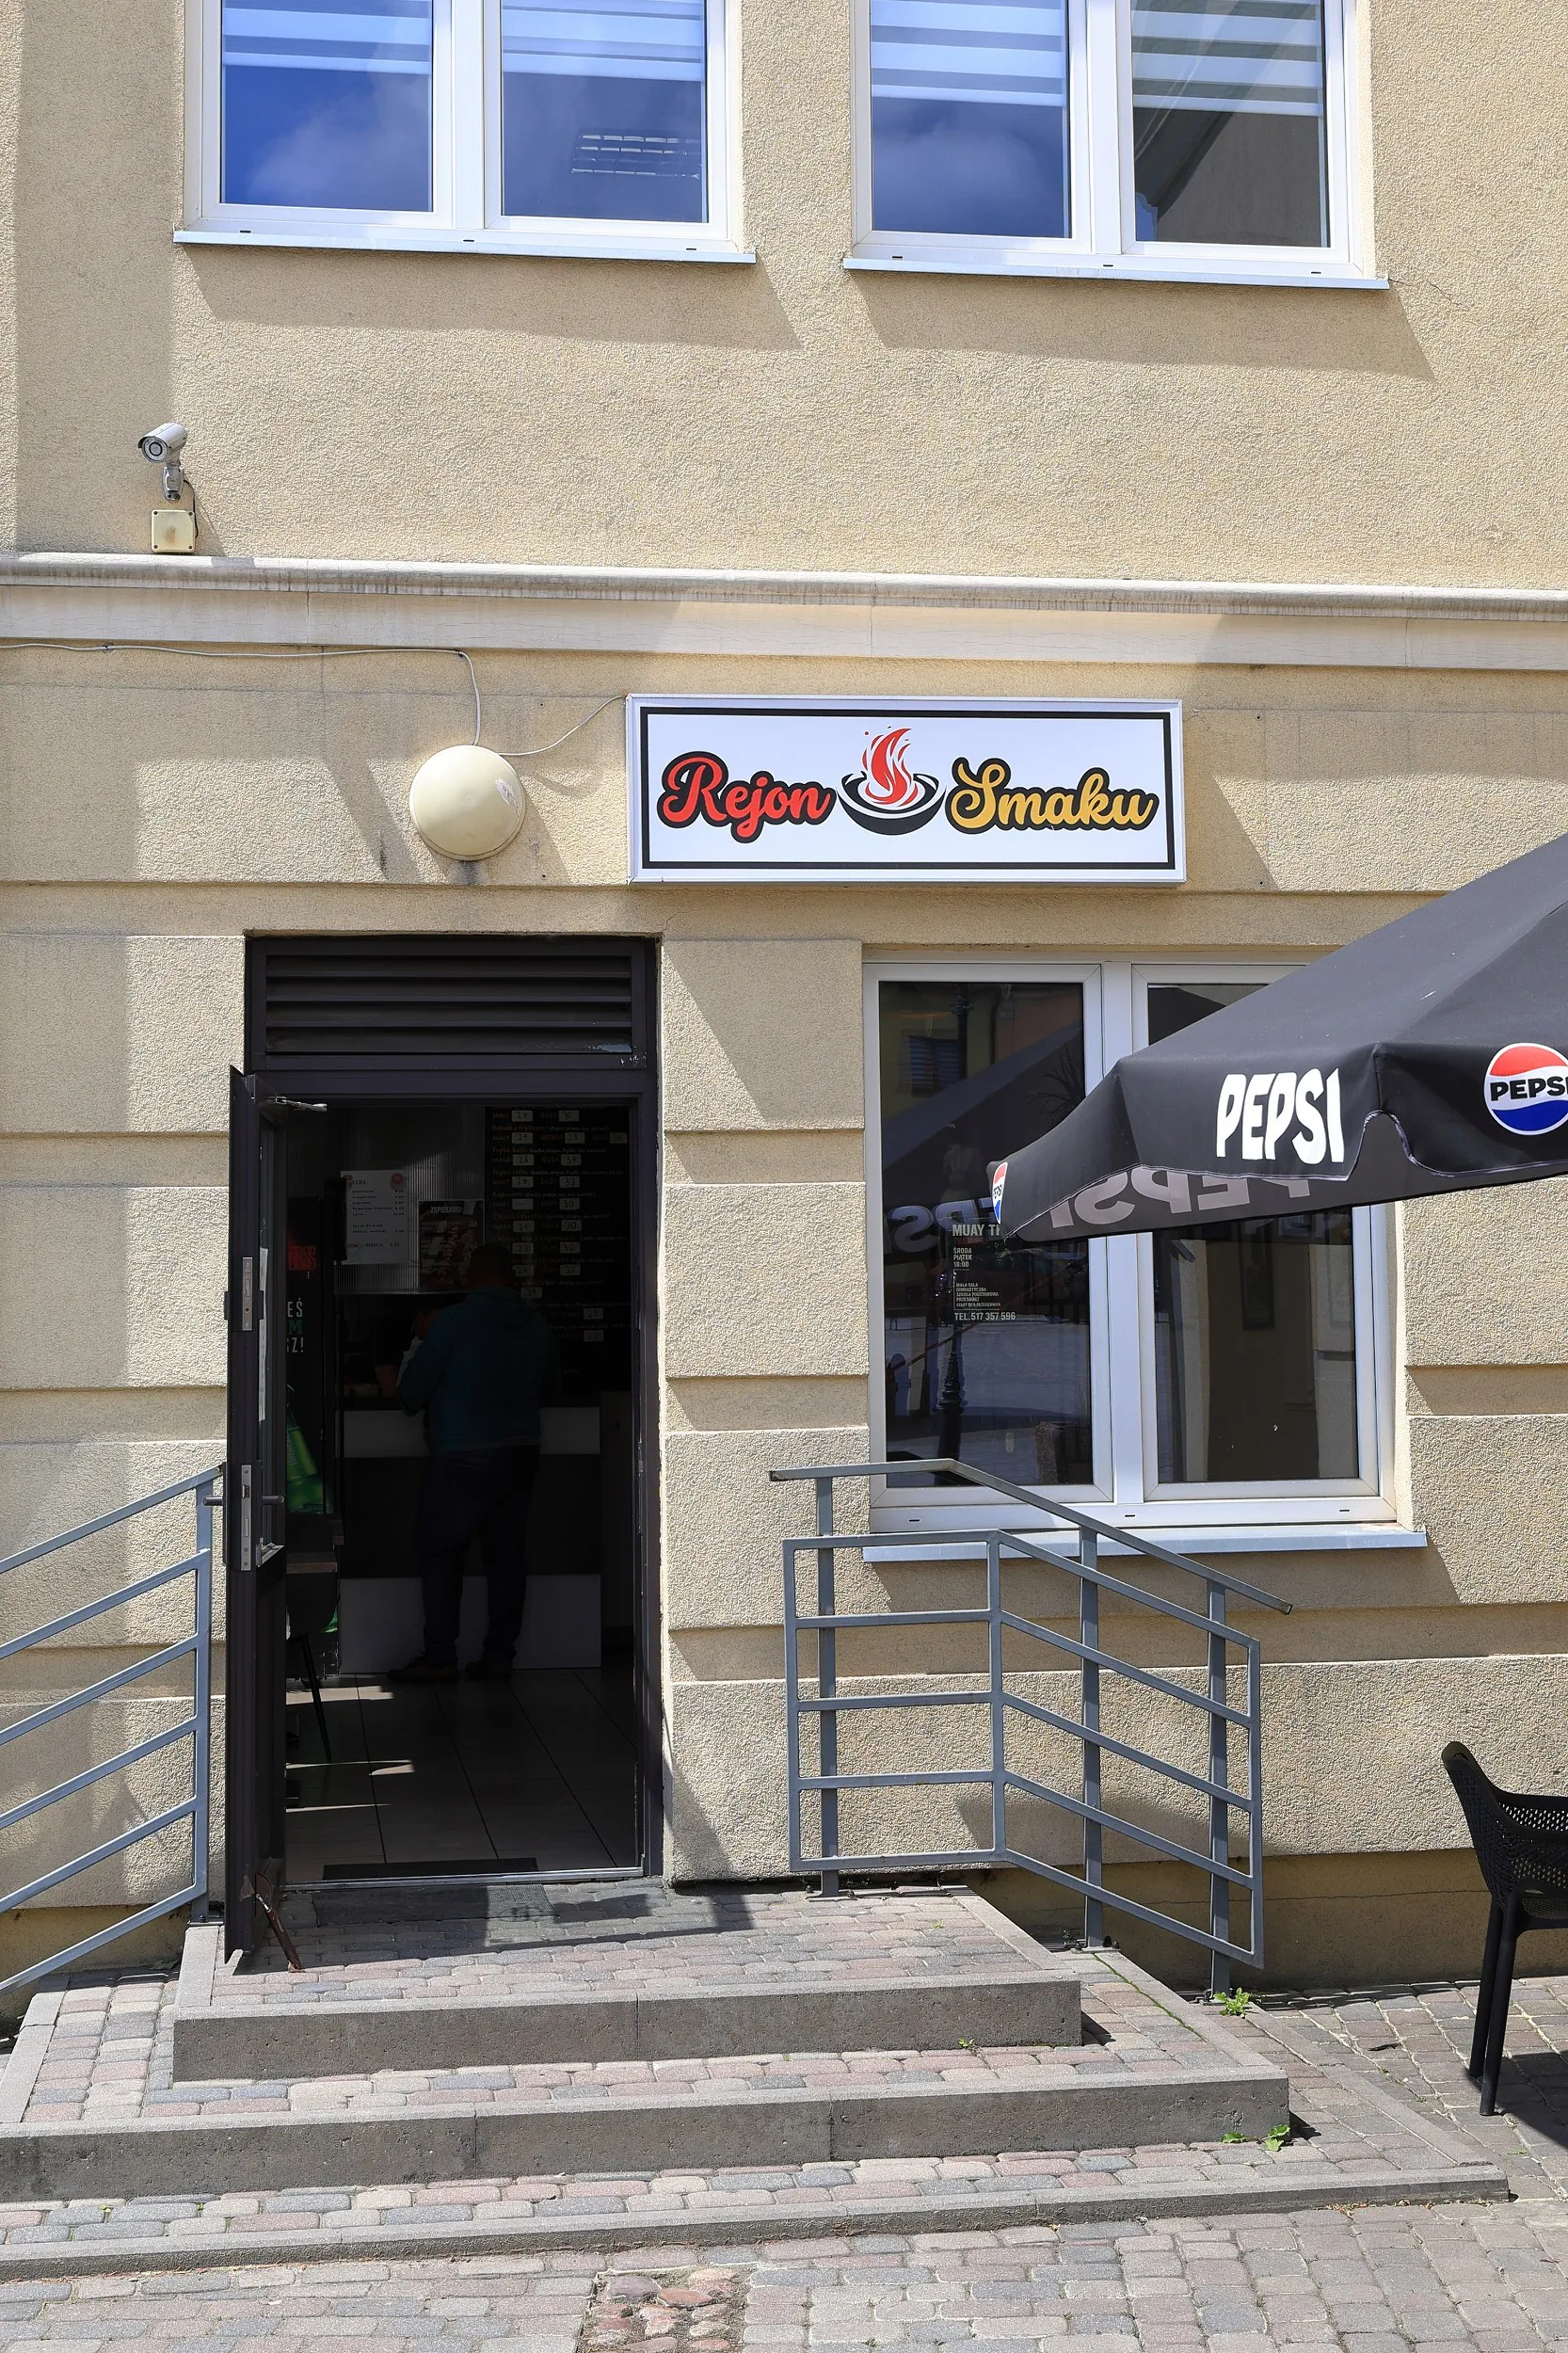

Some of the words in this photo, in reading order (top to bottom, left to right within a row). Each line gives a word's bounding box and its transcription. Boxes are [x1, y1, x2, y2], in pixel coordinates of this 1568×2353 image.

[660, 751, 836, 843] Rejon
[945, 758, 1159, 834] Smaku
[1216, 1067, 1345, 1165] PEPSI
[952, 1225, 984, 1237] MUAY
[984, 1312, 999, 1321] 357
[1001, 1312, 1016, 1321] 596
